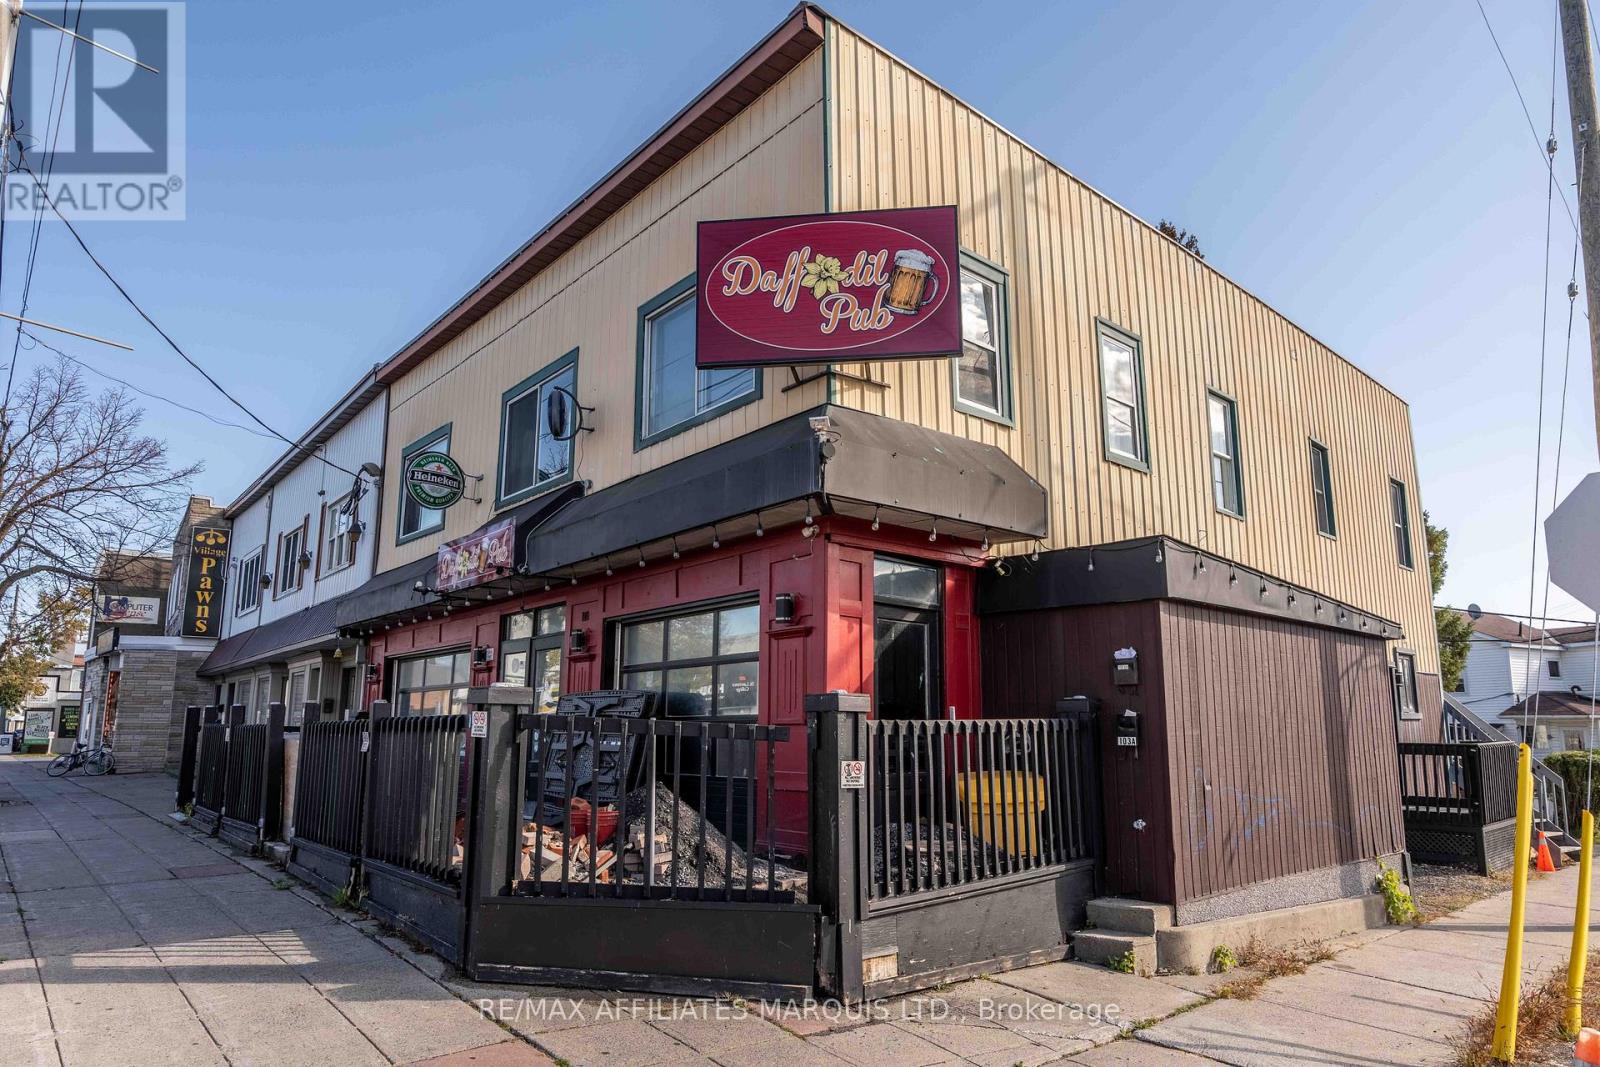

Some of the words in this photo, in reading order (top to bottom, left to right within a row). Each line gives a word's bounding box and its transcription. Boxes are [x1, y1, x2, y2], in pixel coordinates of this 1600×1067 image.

[722, 246, 889, 313] Daffdil
[820, 283, 894, 334] Pub
[414, 471, 459, 488] Heineken
[194, 546, 226, 557] Village
[441, 543, 481, 589] Daffdil
[195, 557, 216, 633] Pawns
